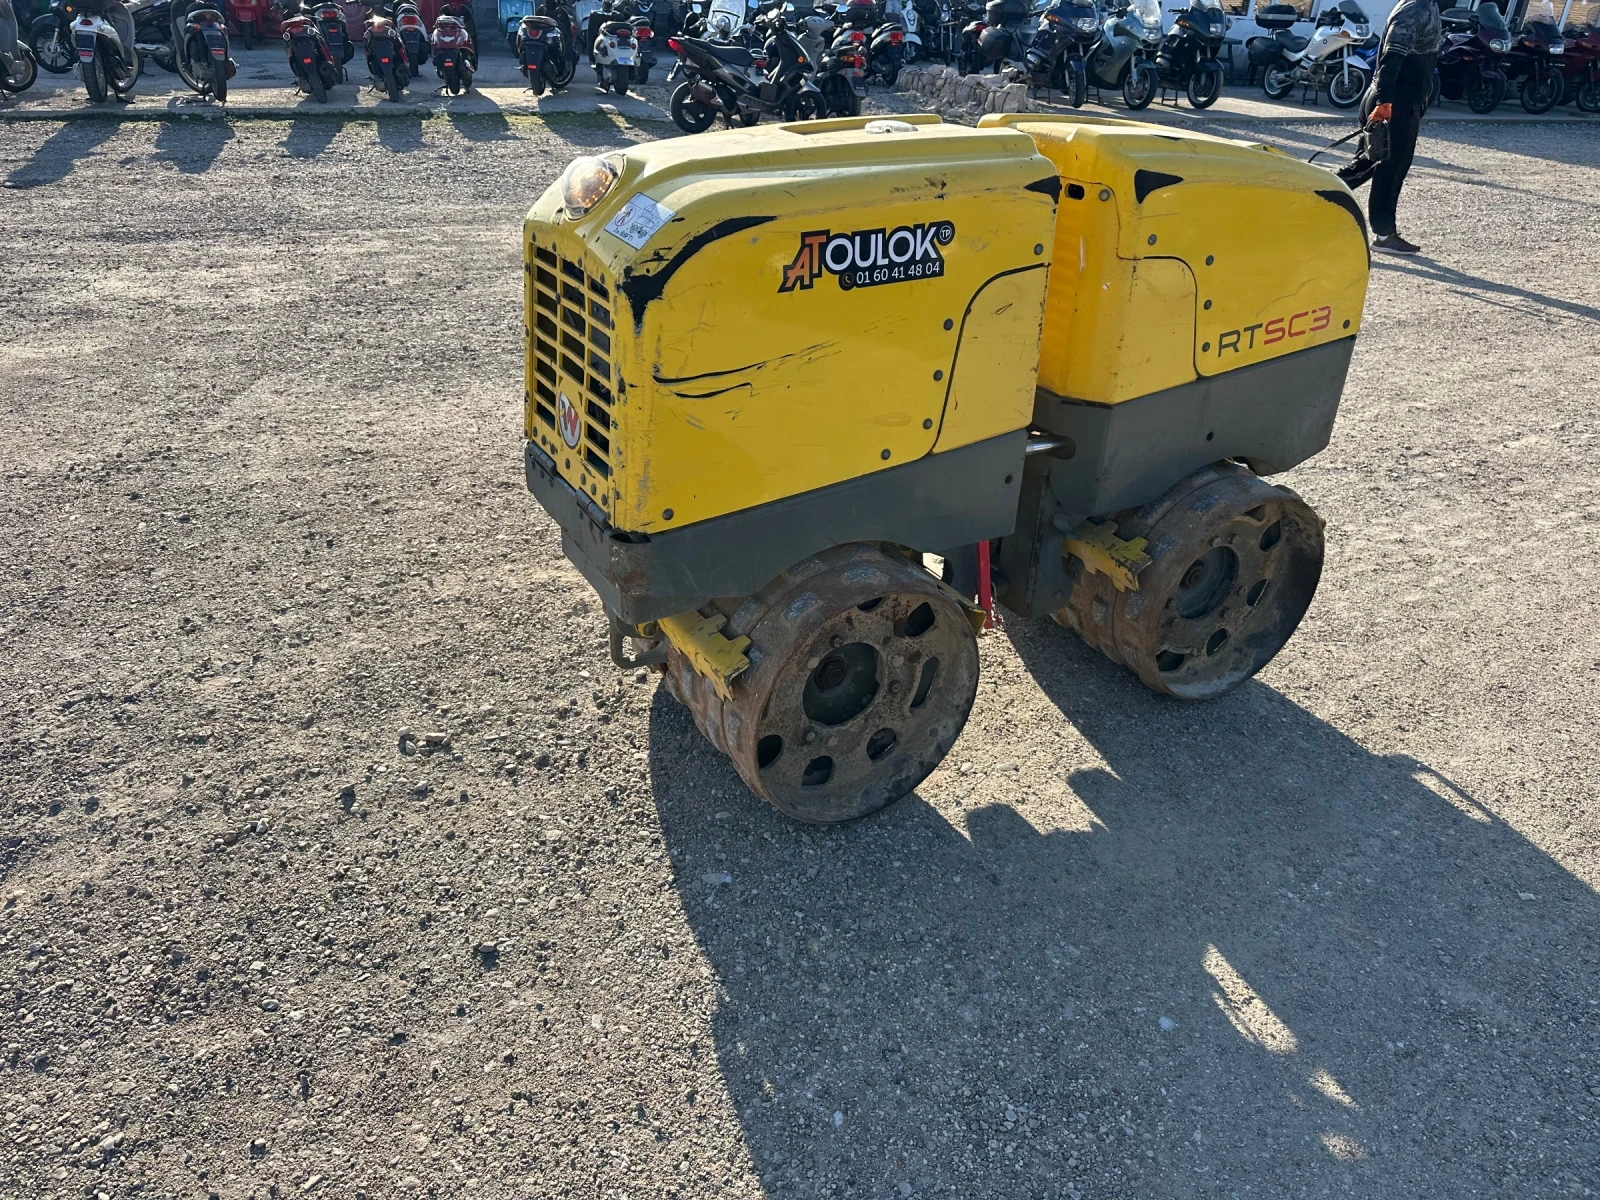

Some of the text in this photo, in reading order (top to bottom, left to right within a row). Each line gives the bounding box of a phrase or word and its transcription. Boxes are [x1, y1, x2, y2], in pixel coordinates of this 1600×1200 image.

[785, 226, 938, 288] ATOULOK
[857, 261, 940, 284] 01 60 41 48 04
[1219, 306, 1331, 358] RTSC3
